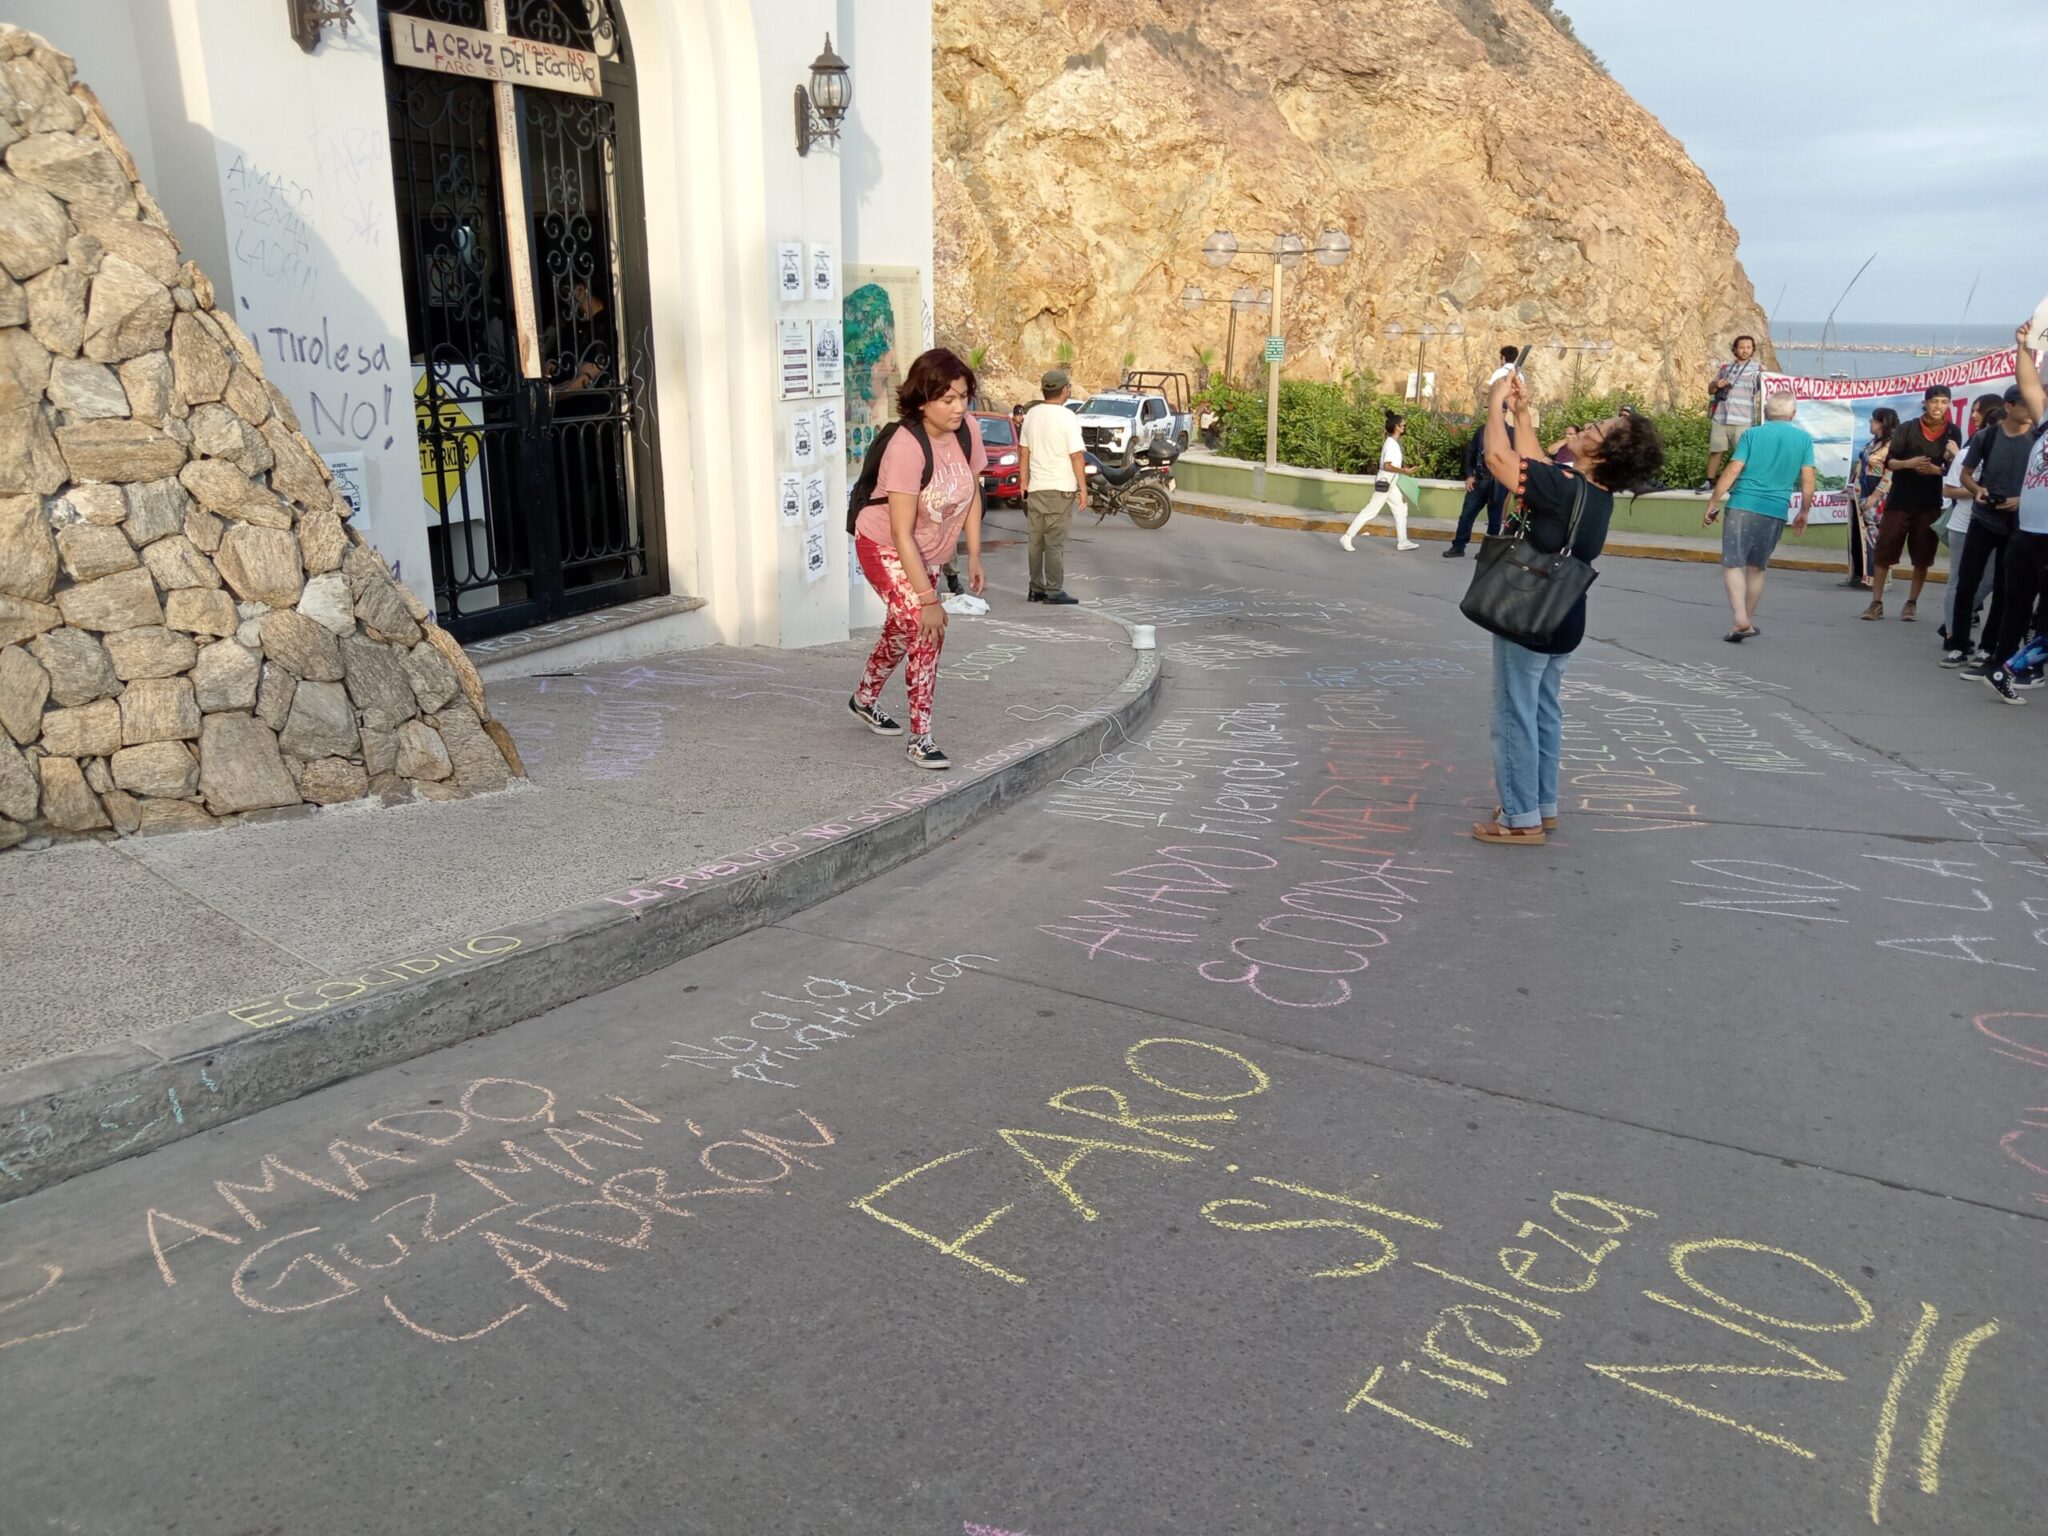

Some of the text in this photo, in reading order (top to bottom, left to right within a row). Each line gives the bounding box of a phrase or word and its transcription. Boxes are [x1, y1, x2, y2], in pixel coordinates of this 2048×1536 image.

[410, 21, 437, 53] LA
[442, 33, 495, 66] CRUZ
[500, 46, 531, 76] DEL
[1812, 377, 1876, 398] DEFENSA
[1948, 361, 1971, 386] DE
[803, 822, 853, 840] NO
[147, 1076, 557, 1287] AMADO
[849, 1036, 1272, 1287] FARO
